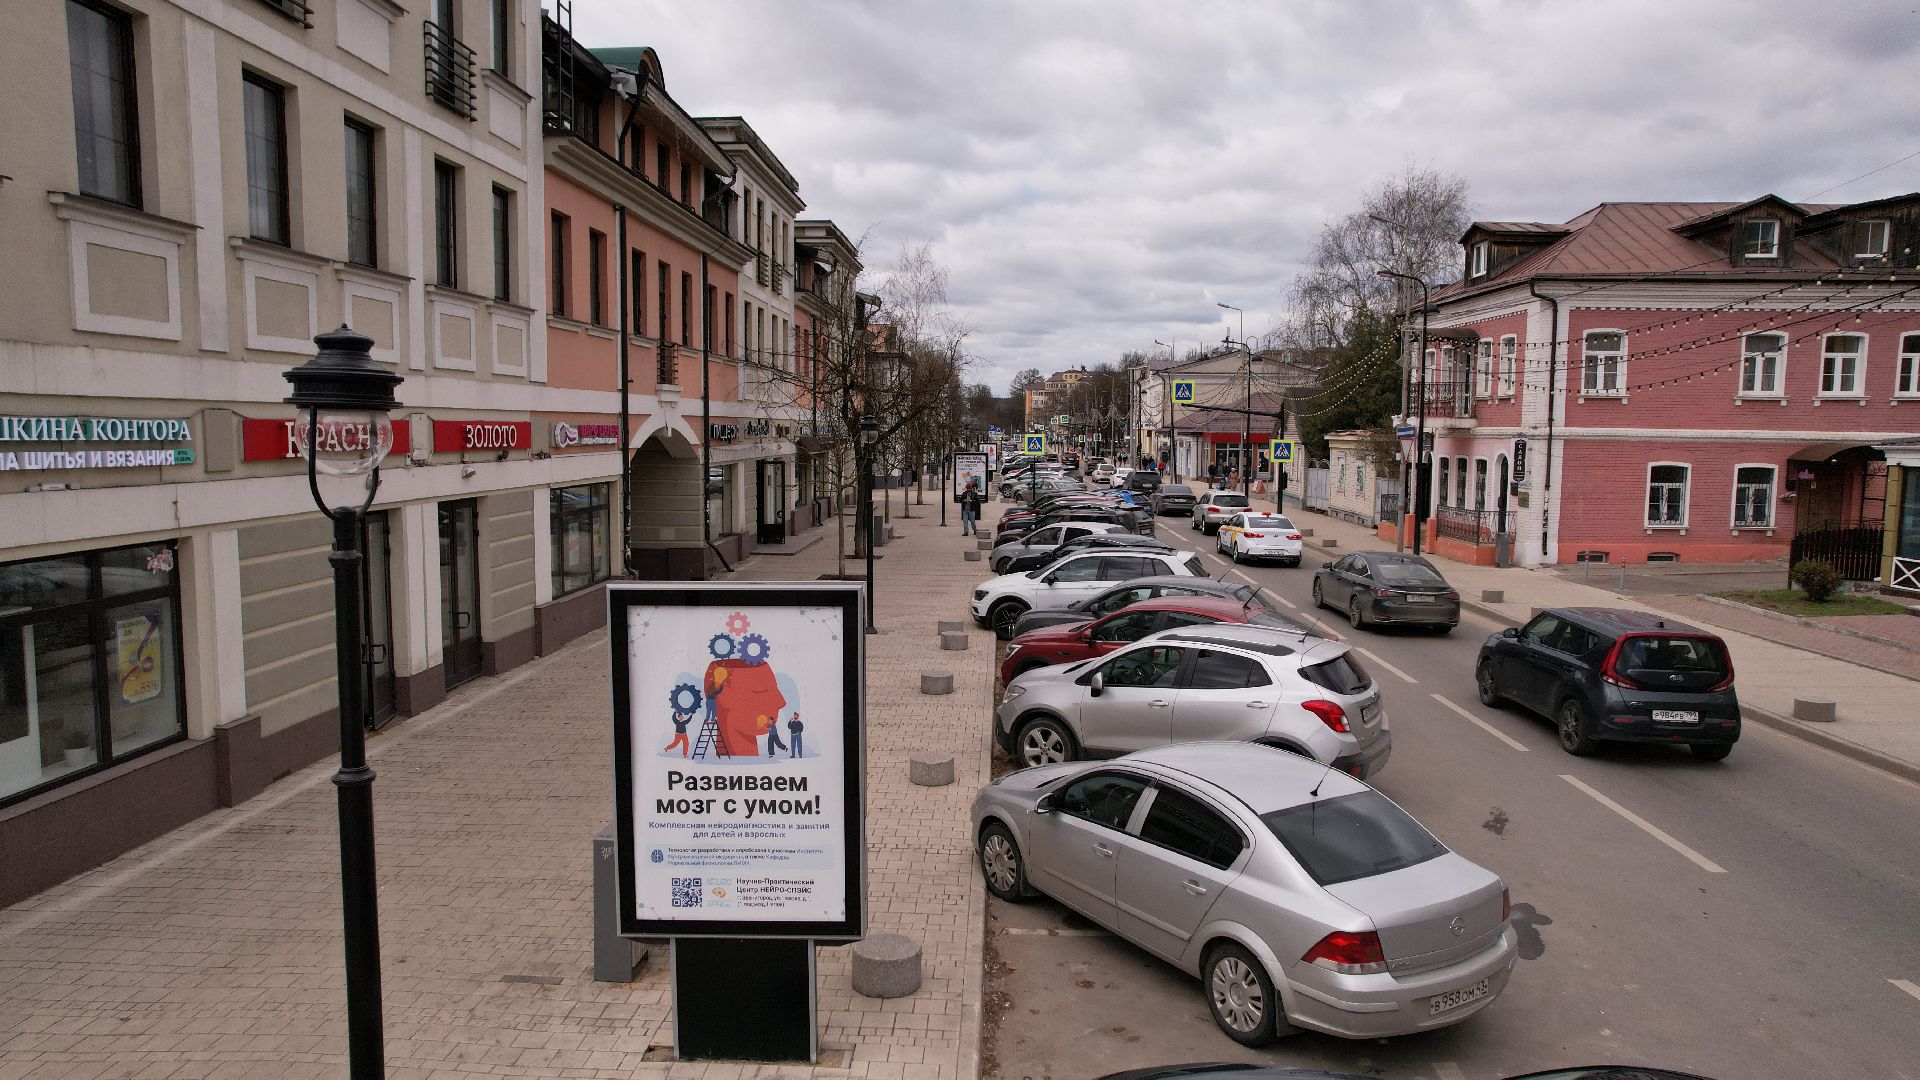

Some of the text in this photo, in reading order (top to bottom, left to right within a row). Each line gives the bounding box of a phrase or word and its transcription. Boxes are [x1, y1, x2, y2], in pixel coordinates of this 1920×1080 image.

[91, 418, 192, 441] КОНТОРА
[466, 424, 517, 448] ЗОЛОТО
[24, 451, 87, 470] ШИТЬЯ
[90, 450, 102, 467] И
[106, 449, 175, 468] ВЯЗАНИЯ
[667, 771, 808, 791] Развиваем
[656, 795, 821, 819] мозг с умом!
[648, 821, 706, 829] Комплексная
[707, 821, 786, 831] нейродиагностика
[692, 831, 709, 839] для
[710, 830, 736, 838] детей
[744, 831, 786, 839] взрослых
[736, 878, 815, 886] Научно-Практический
[736, 885, 812, 894] Центр НЕЙРО-СПЭЙС
